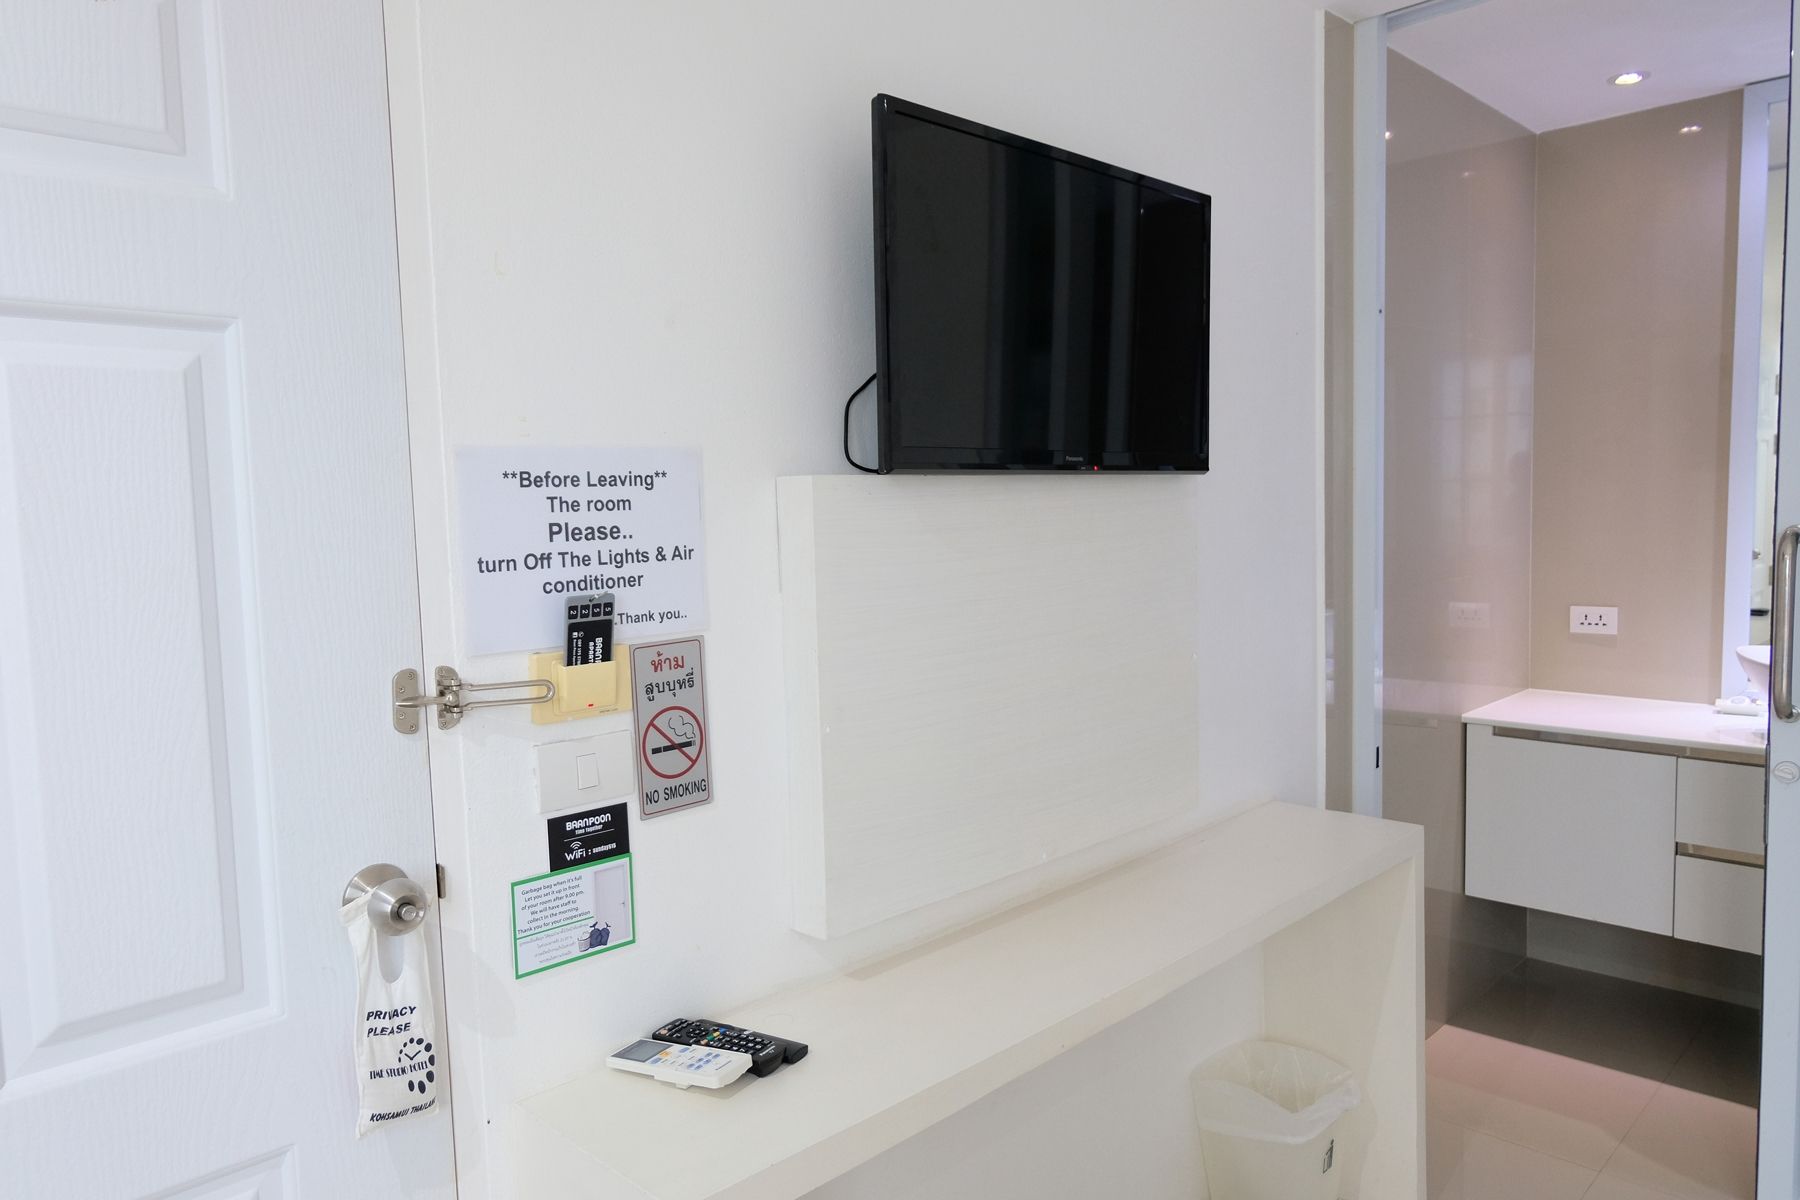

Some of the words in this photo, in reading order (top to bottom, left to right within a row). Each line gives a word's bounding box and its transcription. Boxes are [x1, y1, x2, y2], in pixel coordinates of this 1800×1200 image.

[546, 496, 580, 513] The
[587, 498, 632, 512] room
[549, 522, 633, 542] Please..
[478, 557, 517, 573] turn
[524, 553, 552, 570] Off
[558, 551, 591, 568] The
[597, 547, 650, 568] Lights
[655, 546, 667, 562] &
[671, 545, 694, 561] Air
[543, 574, 644, 594] conditioner
[658, 610, 687, 623] you..
[651, 650, 685, 673] ห้าม
[645, 668, 695, 702] สูบบุหรี่
[645, 789, 660, 805] NO
[664, 778, 707, 801] SMOKING
[565, 813, 612, 831] BAANPOON
[565, 849, 586, 861] WiFi
[522, 886, 542, 896] Garbage
[553, 879, 566, 887] when
[568, 883, 580, 891] front
[527, 902, 539, 910] your
[517, 927, 533, 935] Thank
[551, 918, 562, 926] your
[563, 910, 591, 921] cooperation
[527, 916, 543, 925] collect
[558, 906, 579, 915] morning
[366, 1006, 416, 1021] PRIVACY
[367, 1022, 411, 1038] PLEASE
[370, 1069, 383, 1080] TIME
[386, 1066, 408, 1077] STUDIO
[370, 1108, 410, 1122] KOHSAMUI
